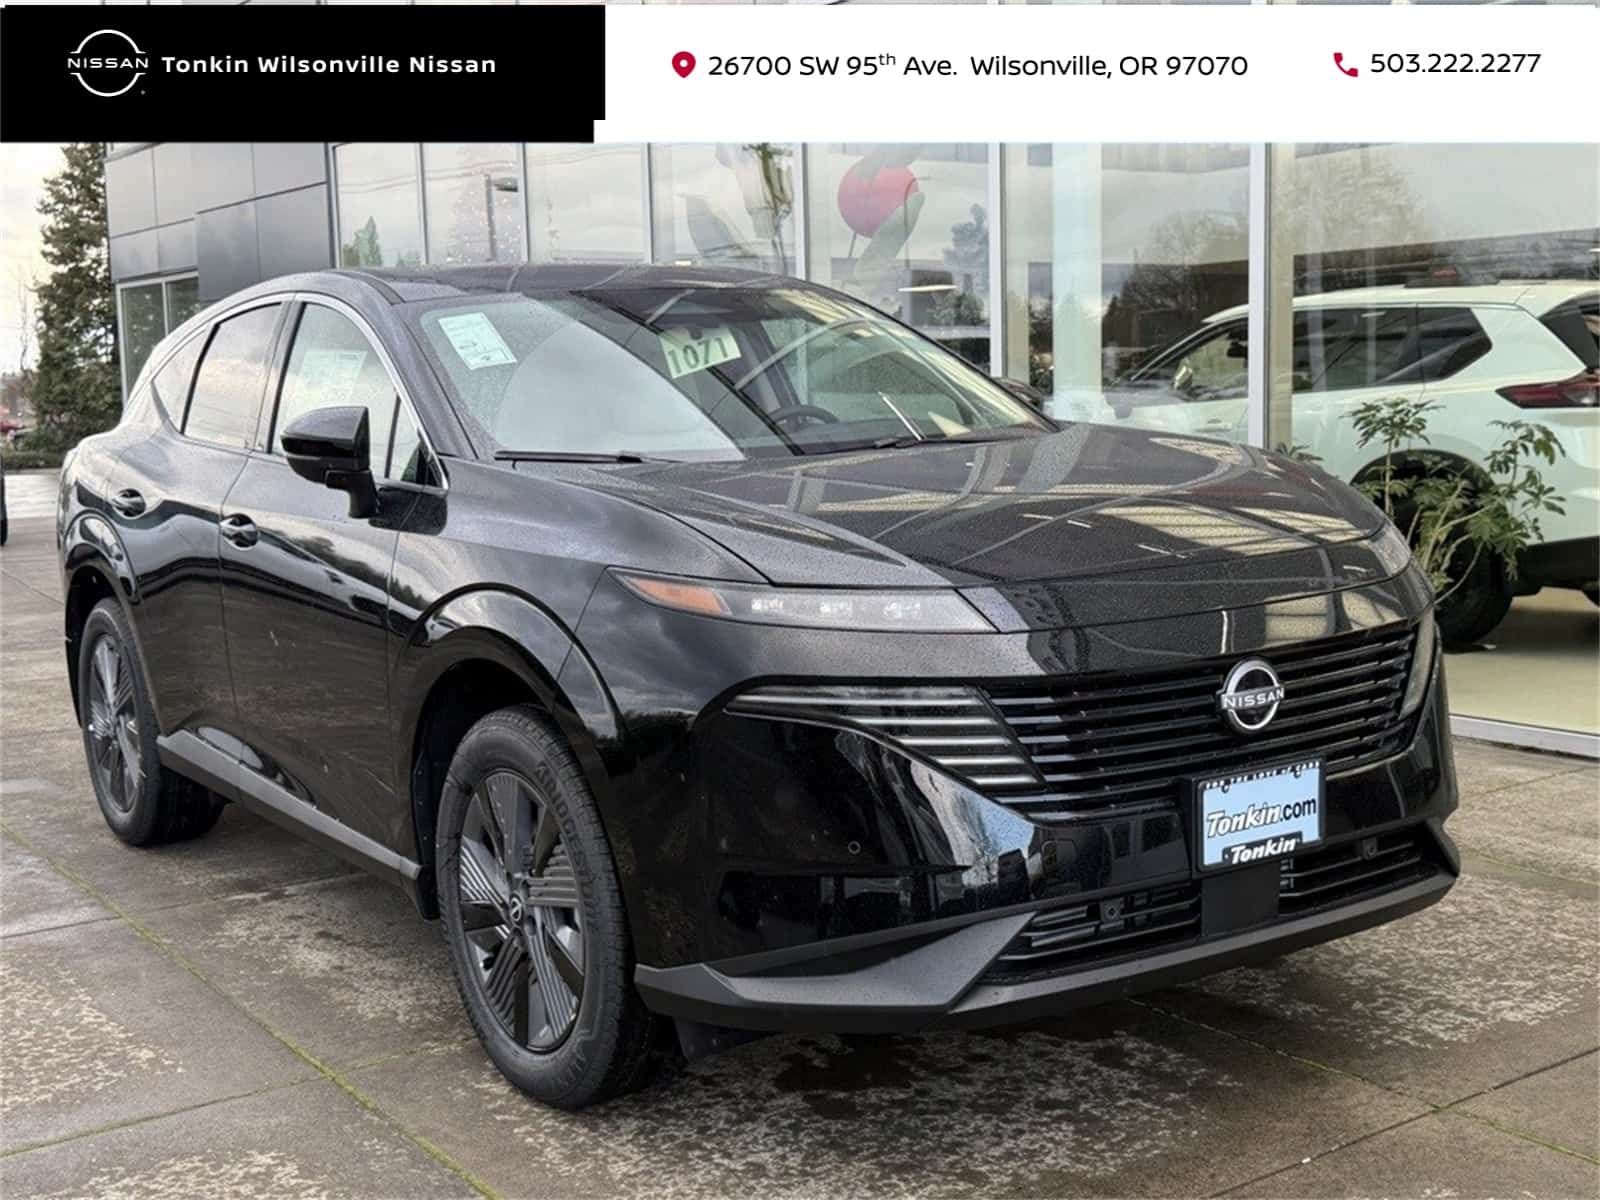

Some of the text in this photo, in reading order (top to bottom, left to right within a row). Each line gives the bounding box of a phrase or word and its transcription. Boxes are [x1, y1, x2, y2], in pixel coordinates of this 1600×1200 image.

[667, 337, 728, 374] 1071
[1220, 686, 1285, 709] NISSAN
[1207, 798, 1317, 838] Tonkin.com
[1230, 838, 1297, 864] Tonkin
